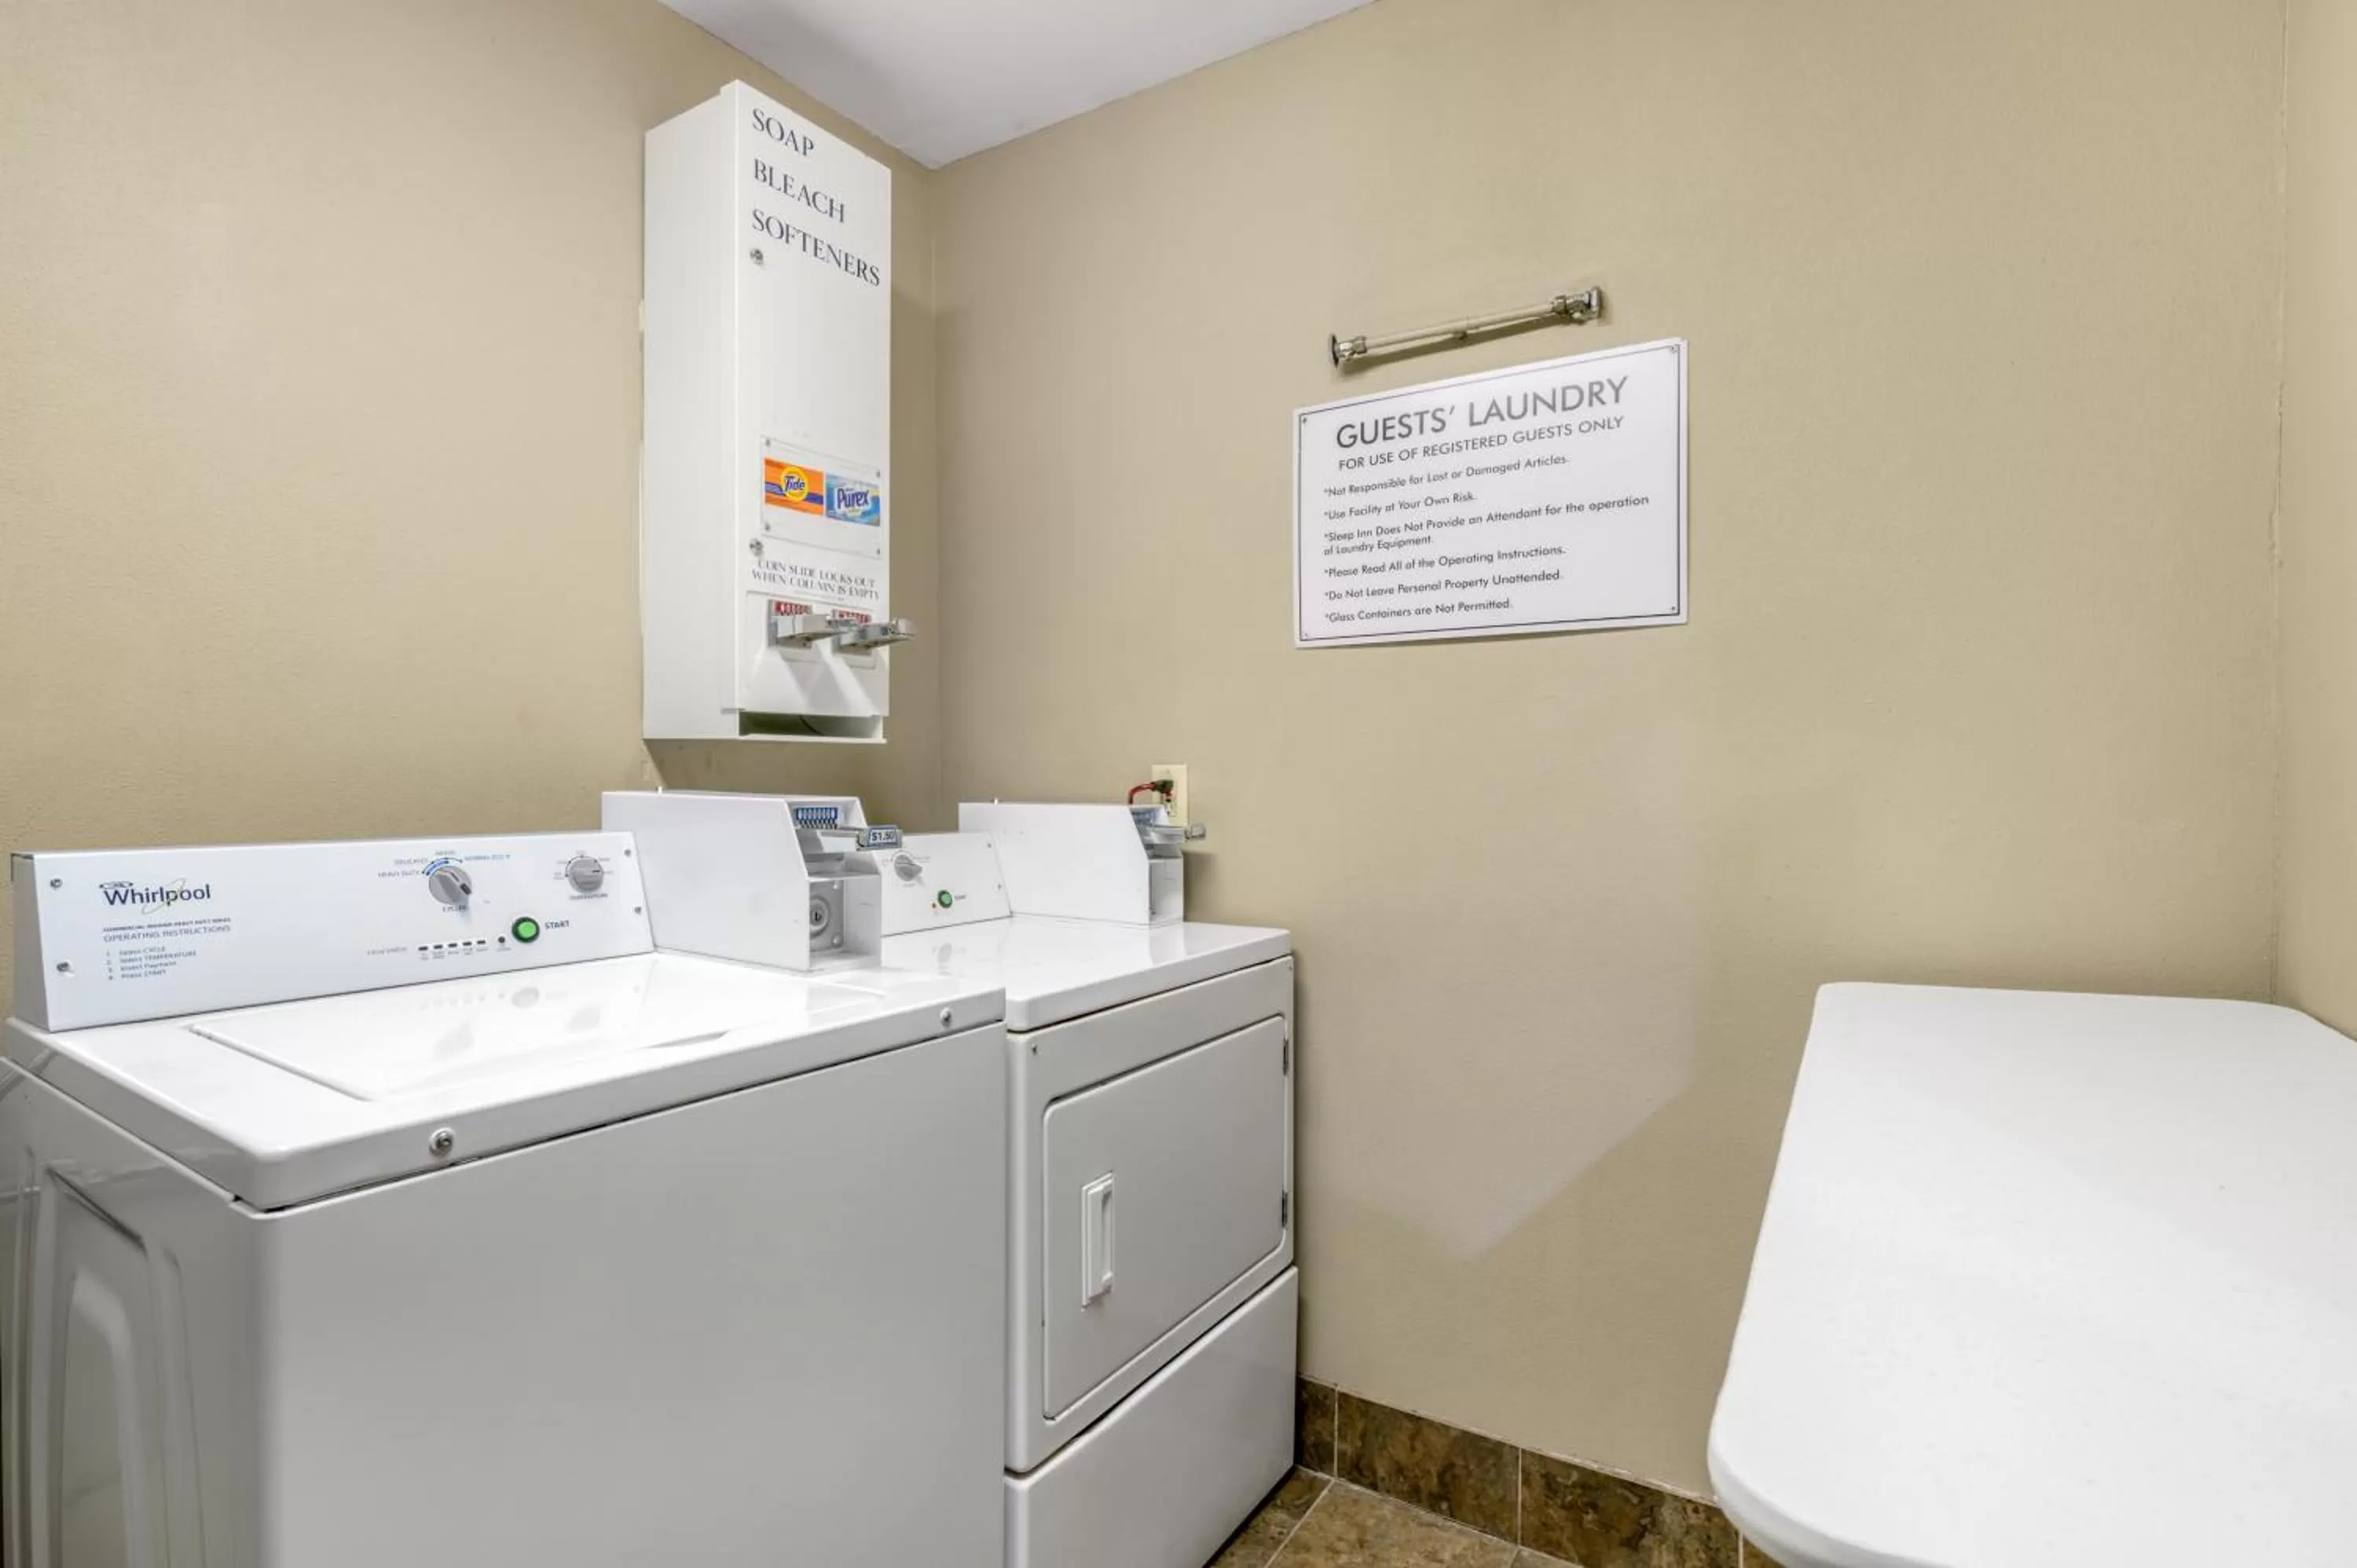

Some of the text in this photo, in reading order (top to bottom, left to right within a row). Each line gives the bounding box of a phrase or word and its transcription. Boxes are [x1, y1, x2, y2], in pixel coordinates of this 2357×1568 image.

[752, 108, 814, 157] SOAP
[753, 158, 845, 223] BLEACH
[751, 207, 880, 287] SOFTENERS
[1468, 375, 1629, 427] LAUNDRY
[1338, 415, 1625, 471] FOR USE OF REGISTERED GUESTS ONLY
[783, 474, 806, 492] Tide
[1348, 475, 1407, 494] Responsible
[1409, 474, 1424, 485] for
[1427, 471, 1449, 482] Lost
[1451, 470, 1463, 479] or
[1464, 460, 1521, 478] Damaged
[837, 487, 871, 510] Purex
[1349, 504, 1383, 517] Facility
[1385, 503, 1395, 511] at
[1398, 500, 1421, 510] Your
[1424, 496, 1450, 507] Own
[1453, 490, 1477, 503] Risk.
[1357, 529, 1373, 539] Inn
[1375, 525, 1402, 537] Does
[1404, 522, 1424, 533] Not
[1426, 516, 1466, 529] Provide
[1468, 516, 1483, 526] an
[1486, 507, 1541, 523] Attendant
[1545, 504, 1563, 516] for
[1565, 502, 1585, 513] the
[1588, 494, 1650, 512] operation
[1324, 535, 1434, 556] of Laundry Equipment.
[1362, 562, 1386, 575] Read
[1388, 560, 1402, 571] All
[1405, 559, 1415, 570] of
[1417, 557, 1435, 568] the
[1438, 551, 1494, 569] Operating
[1497, 545, 1567, 561] Instructions.
[752, 568, 786, 585] WHEN
[1345, 587, 1364, 599] Not
[1366, 585, 1395, 597] Leave
[1398, 581, 1442, 595] Personal
[1445, 577, 1490, 591] Property
[1492, 568, 1564, 585] Unattended.
[1358, 608, 1413, 621] Containers
[1414, 606, 1432, 616] are
[1435, 603, 1455, 614] Not
[1457, 598, 1513, 613] Permitted.
[103, 883, 211, 907] Whirlpool
[103, 932, 160, 943] OPERATING
[544, 920, 570, 930] START
